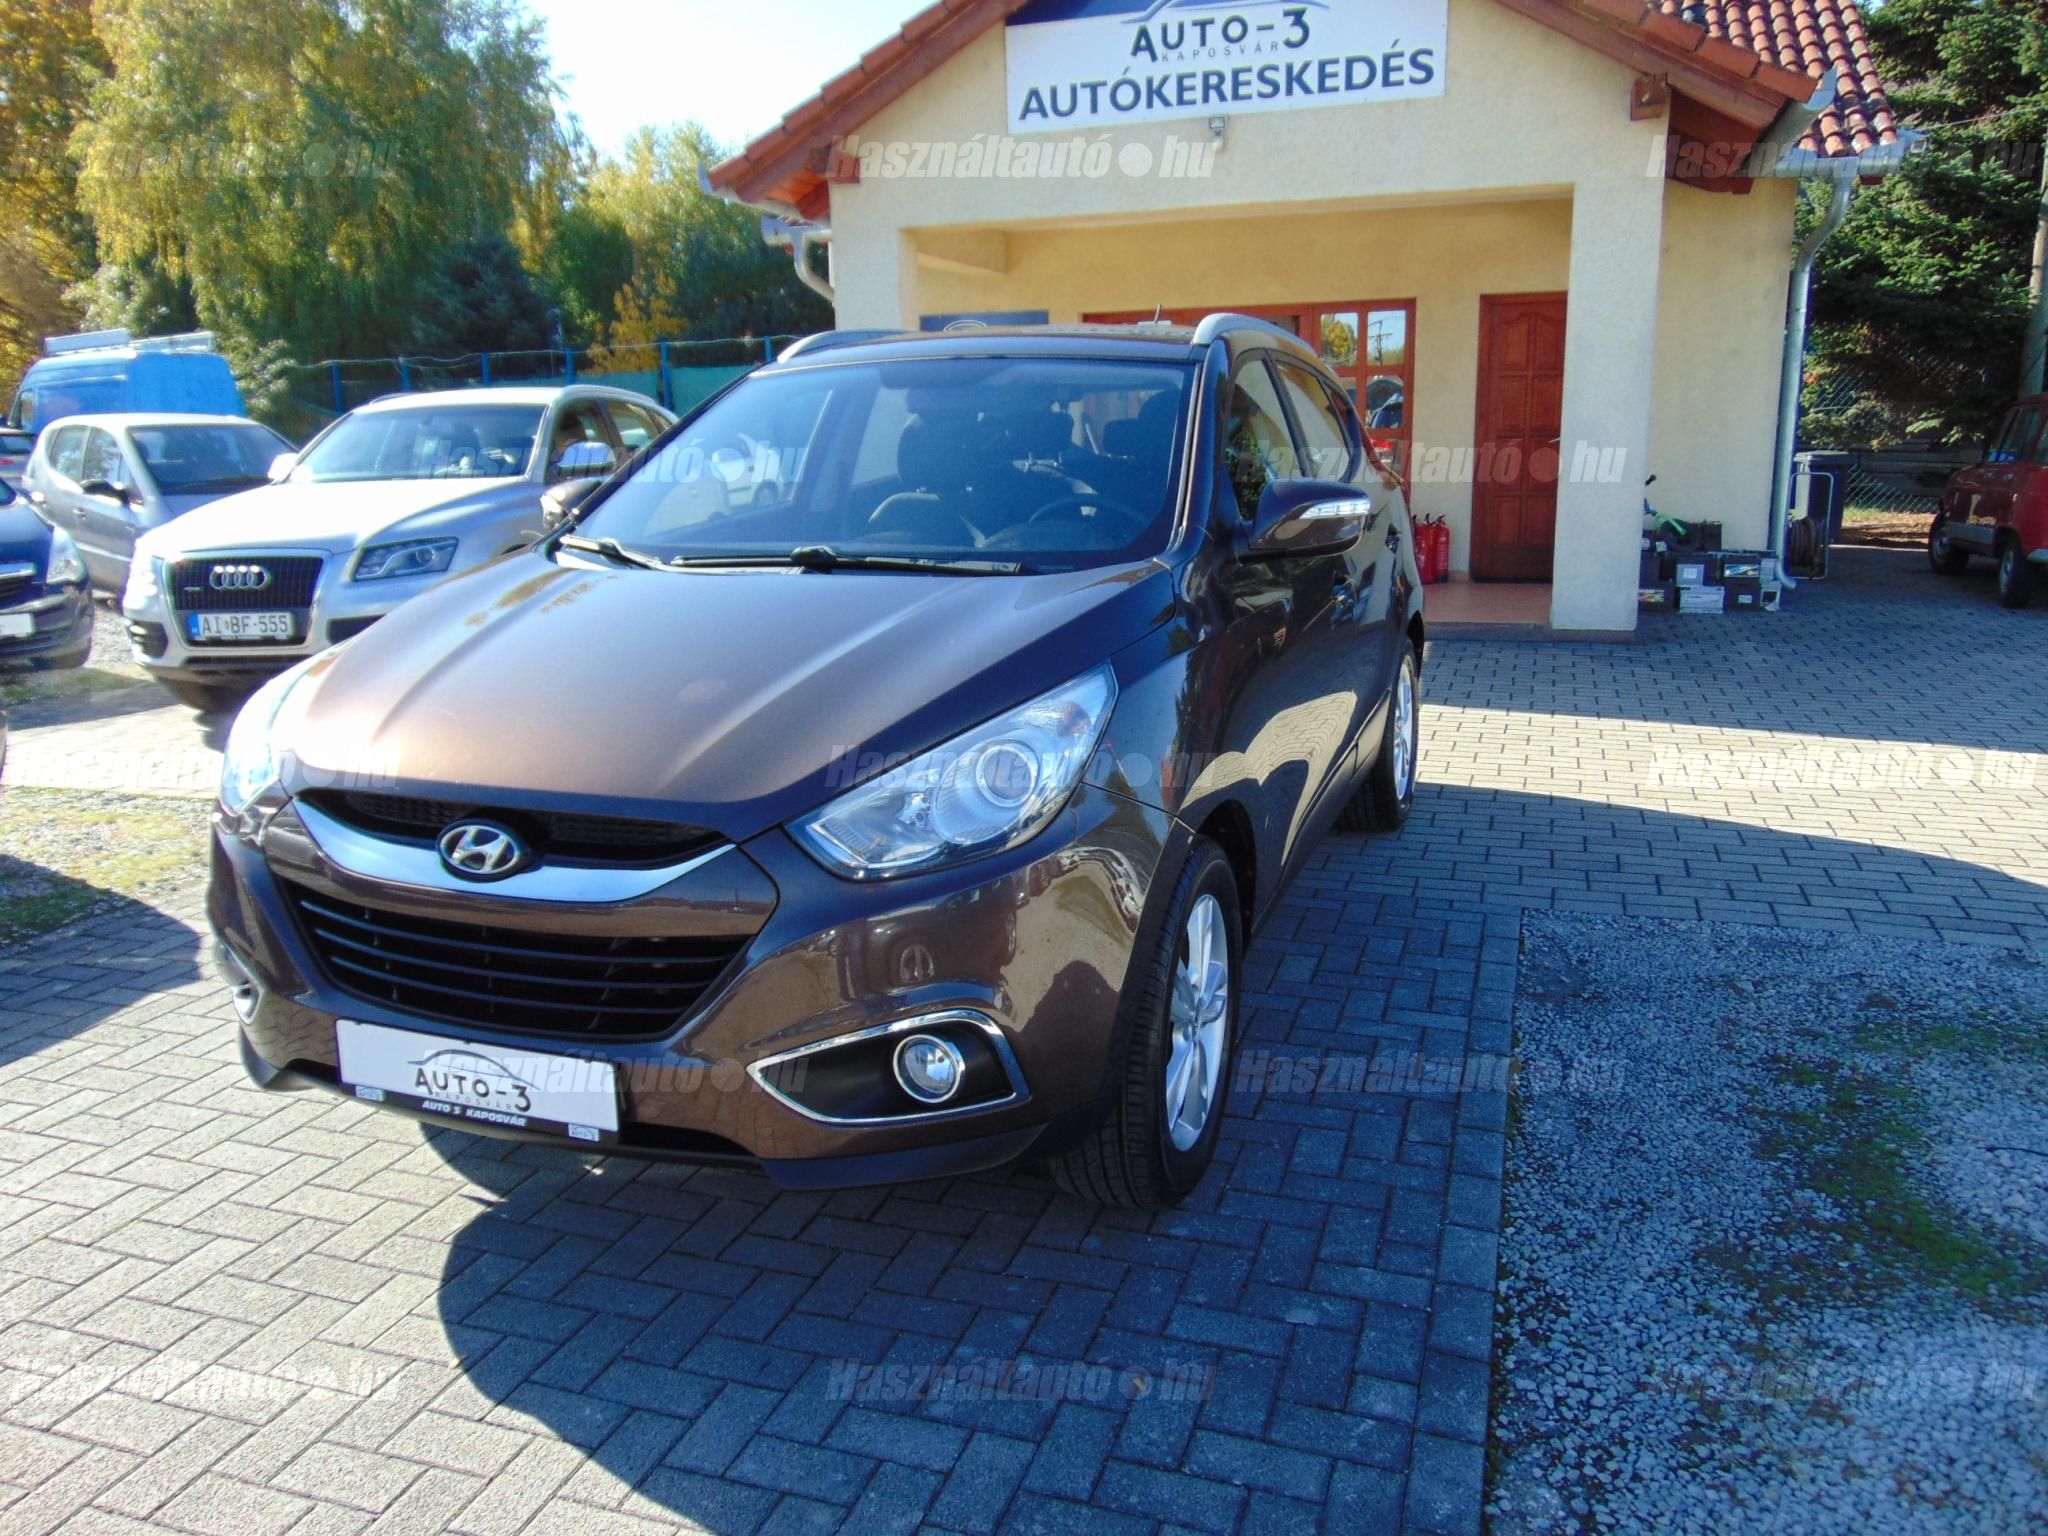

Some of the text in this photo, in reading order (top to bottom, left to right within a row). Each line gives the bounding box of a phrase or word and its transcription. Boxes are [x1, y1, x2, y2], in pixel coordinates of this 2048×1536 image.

[1162, 40, 1278, 61] KAPOSVÁR
[1019, 39, 1435, 120] AUTÓKERESKEDÉS
[421, 1100, 528, 1127] AUTO 3 KAPOSVÁR
